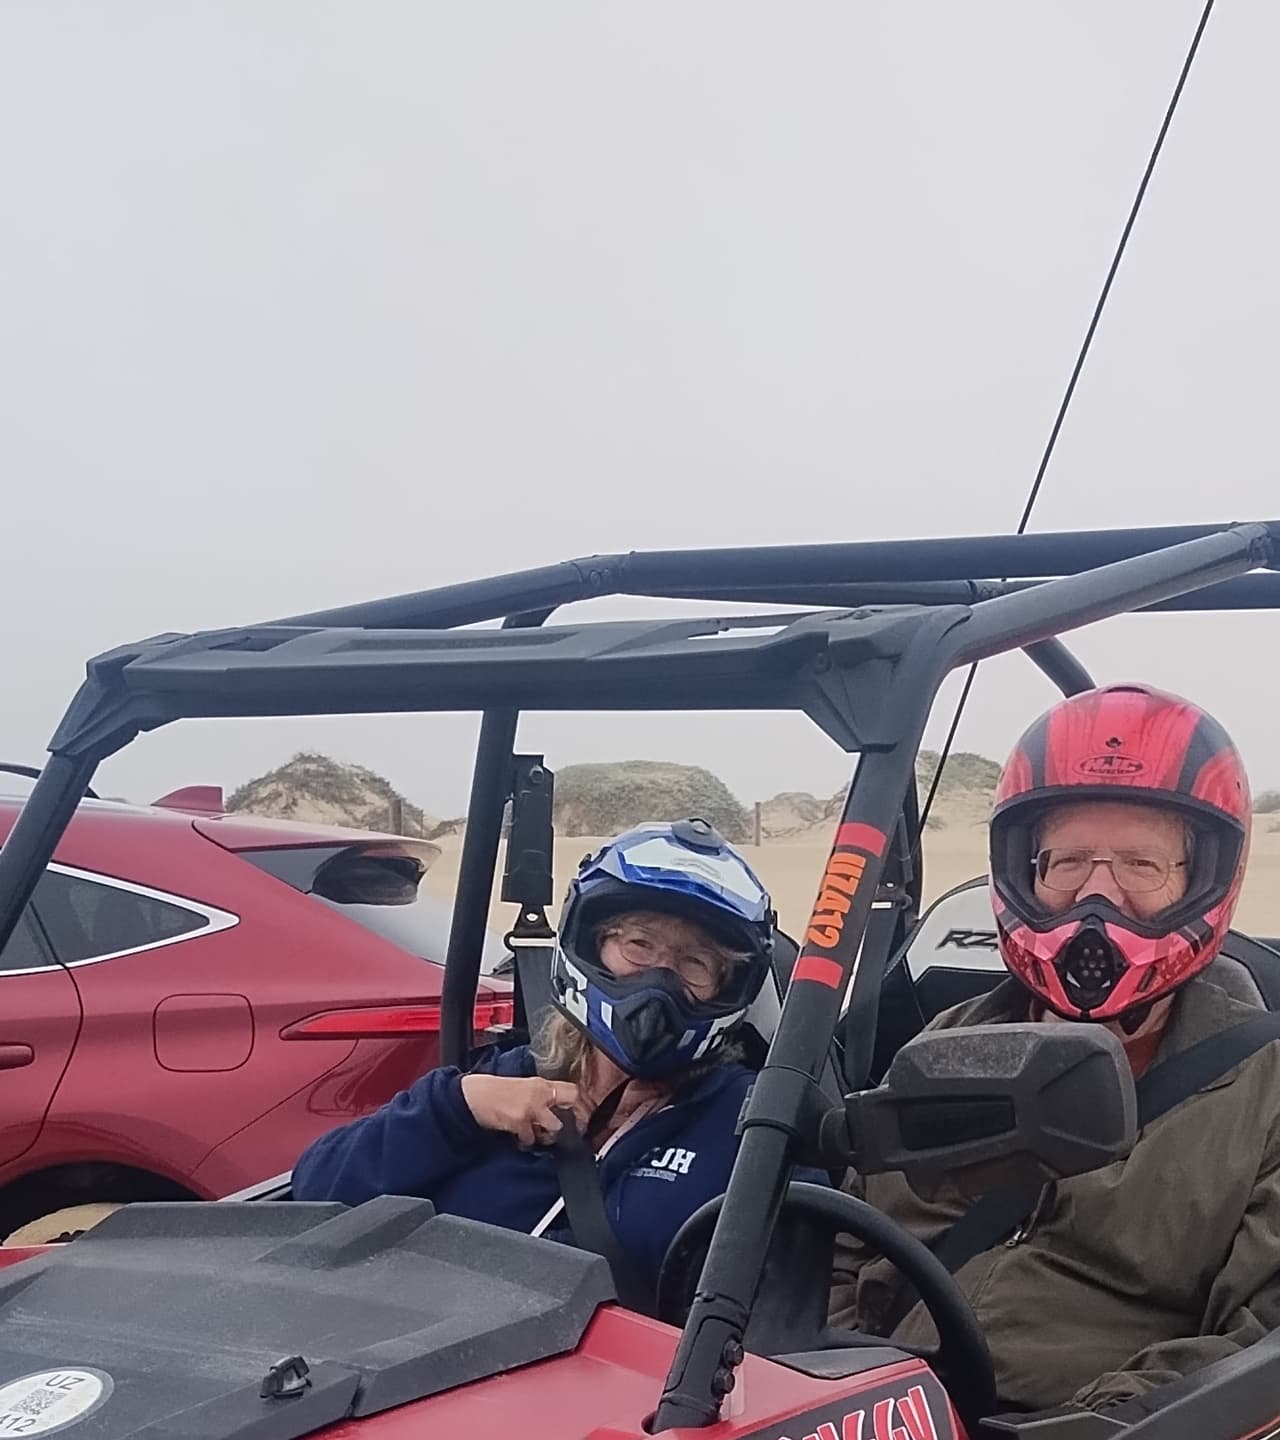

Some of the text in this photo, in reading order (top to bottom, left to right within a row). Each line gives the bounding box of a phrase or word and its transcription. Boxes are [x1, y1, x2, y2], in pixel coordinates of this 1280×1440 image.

[808, 852, 866, 949] UZ412
[639, 1147, 696, 1174] JH
[45, 1374, 86, 1391] UZ
